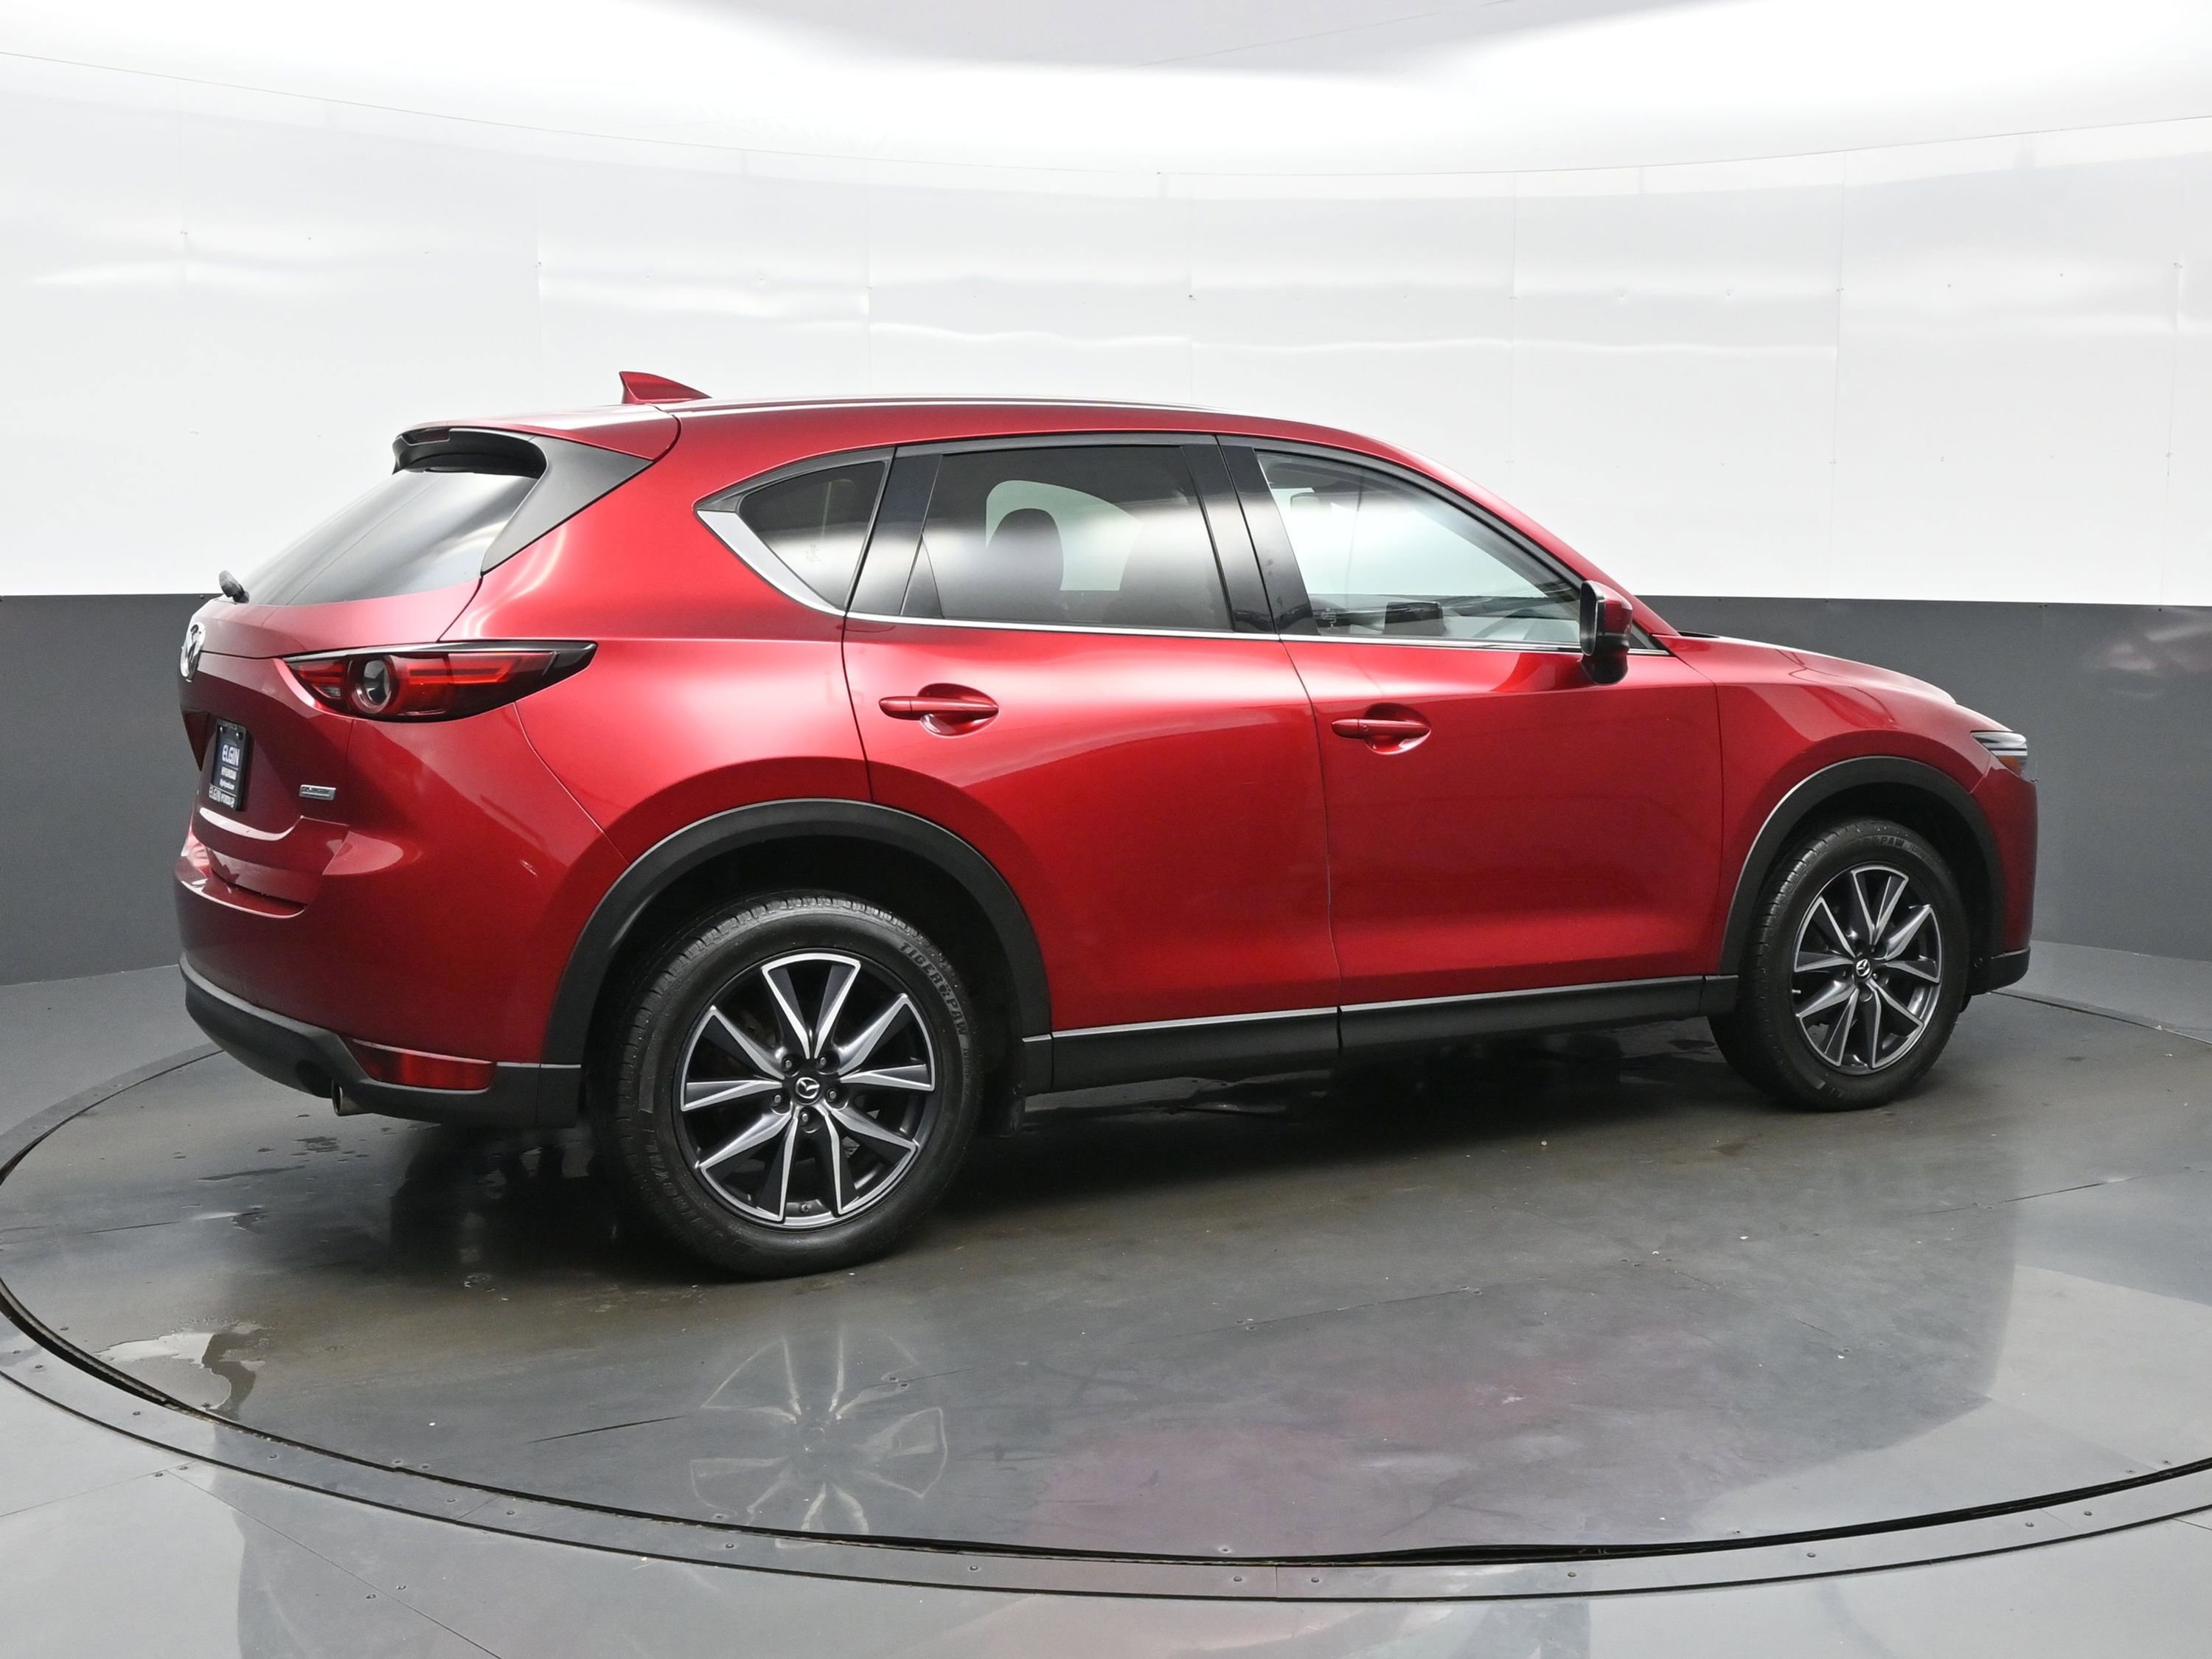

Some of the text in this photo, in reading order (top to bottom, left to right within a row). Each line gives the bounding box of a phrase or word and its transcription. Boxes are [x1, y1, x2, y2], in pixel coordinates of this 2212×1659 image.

[222, 744, 240, 766] ELGIN
[900, 942, 967, 1035] TIGER PAW
